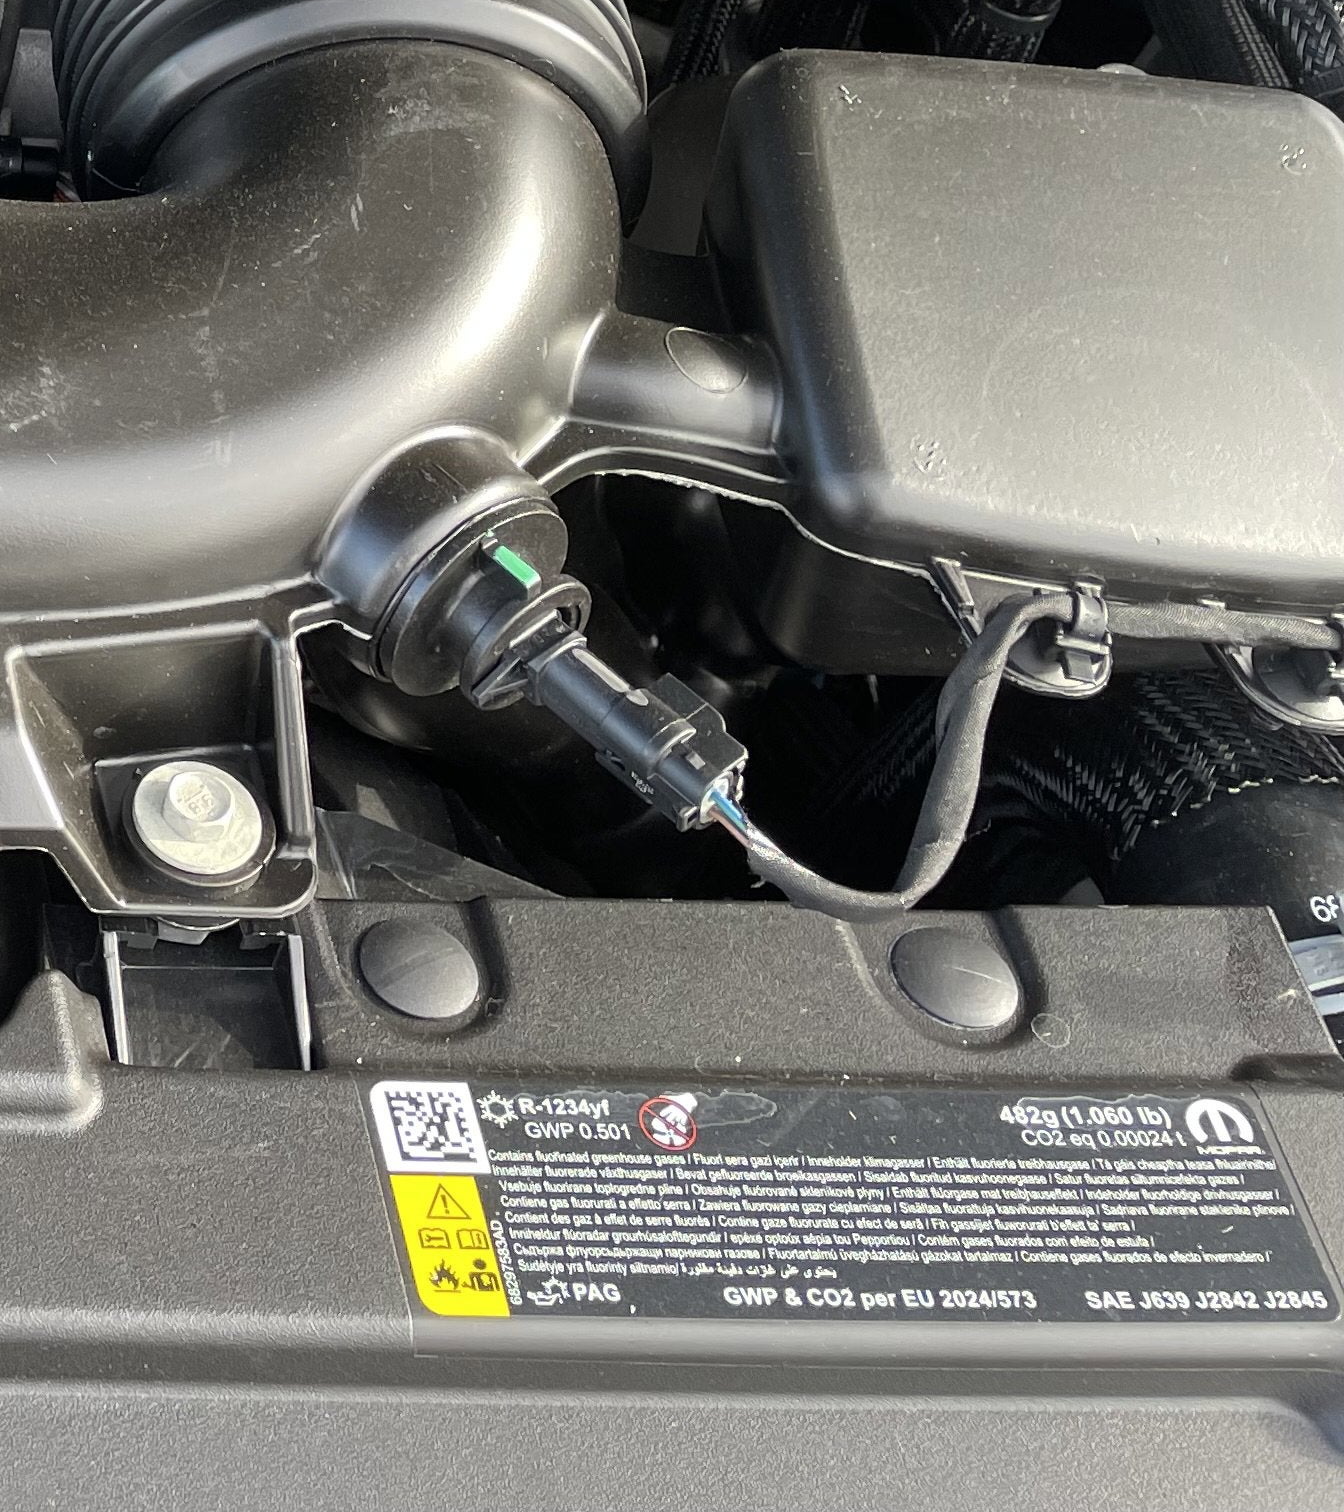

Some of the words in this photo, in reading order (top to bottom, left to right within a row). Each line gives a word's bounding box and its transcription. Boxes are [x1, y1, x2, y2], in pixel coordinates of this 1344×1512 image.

[517, 1097, 610, 1119] R-1234yf
[999, 1105, 1059, 1128] 482g
[1061, 1106, 1133, 1129] (1.060
[1136, 1106, 1172, 1129] lb)
[524, 1122, 574, 1139] GWP
[579, 1123, 631, 1140] 0.501
[1020, 1129, 1067, 1146] CO2
[1070, 1134, 1099, 1151] eq
[1099, 1131, 1173, 1147] 0.00024
[1176, 1131, 1187, 1147] t
[488, 1149, 534, 1161] Contains
[592, 1152, 652, 1166] greenhouse
[654, 1154, 685, 1167] gases
[807, 1155, 861, 1168] Inneholder
[1018, 1158, 1090, 1172] treibhausgase
[550, 1198, 570, 1210] gas
[664, 1200, 691, 1210] serra
[802, 1202, 826, 1215] gazy
[504, 1210, 550, 1224] Contient
[550, 1212, 570, 1224] des
[573, 1214, 592, 1227] gaz
[629, 1214, 643, 1226] de
[762, 1217, 788, 1230] gaze
[841, 1218, 854, 1229] cu
[856, 1217, 882, 1229] efect
[884, 1218, 898, 1229] de
[962, 1236, 994, 1248] gases
[1100, 1236, 1115, 1248] de
[490, 1220, 523, 1305] 68297583AD
[1070, 1252, 1102, 1265] gases
[1154, 1251, 1168, 1263] de
[572, 1283, 621, 1302] PAG
[723, 1287, 779, 1307] GWP
[785, 1287, 803, 1307] &
[807, 1287, 857, 1308] CO2
[861, 1291, 897, 1311] per
[901, 1288, 934, 1308] EU
[938, 1290, 1038, 1309] 2024/573
[1084, 1290, 1136, 1309] SAE
[1139, 1290, 1191, 1310] J639
[1195, 1290, 1260, 1310] J2842
[1263, 1290, 1328, 1309] J2845
